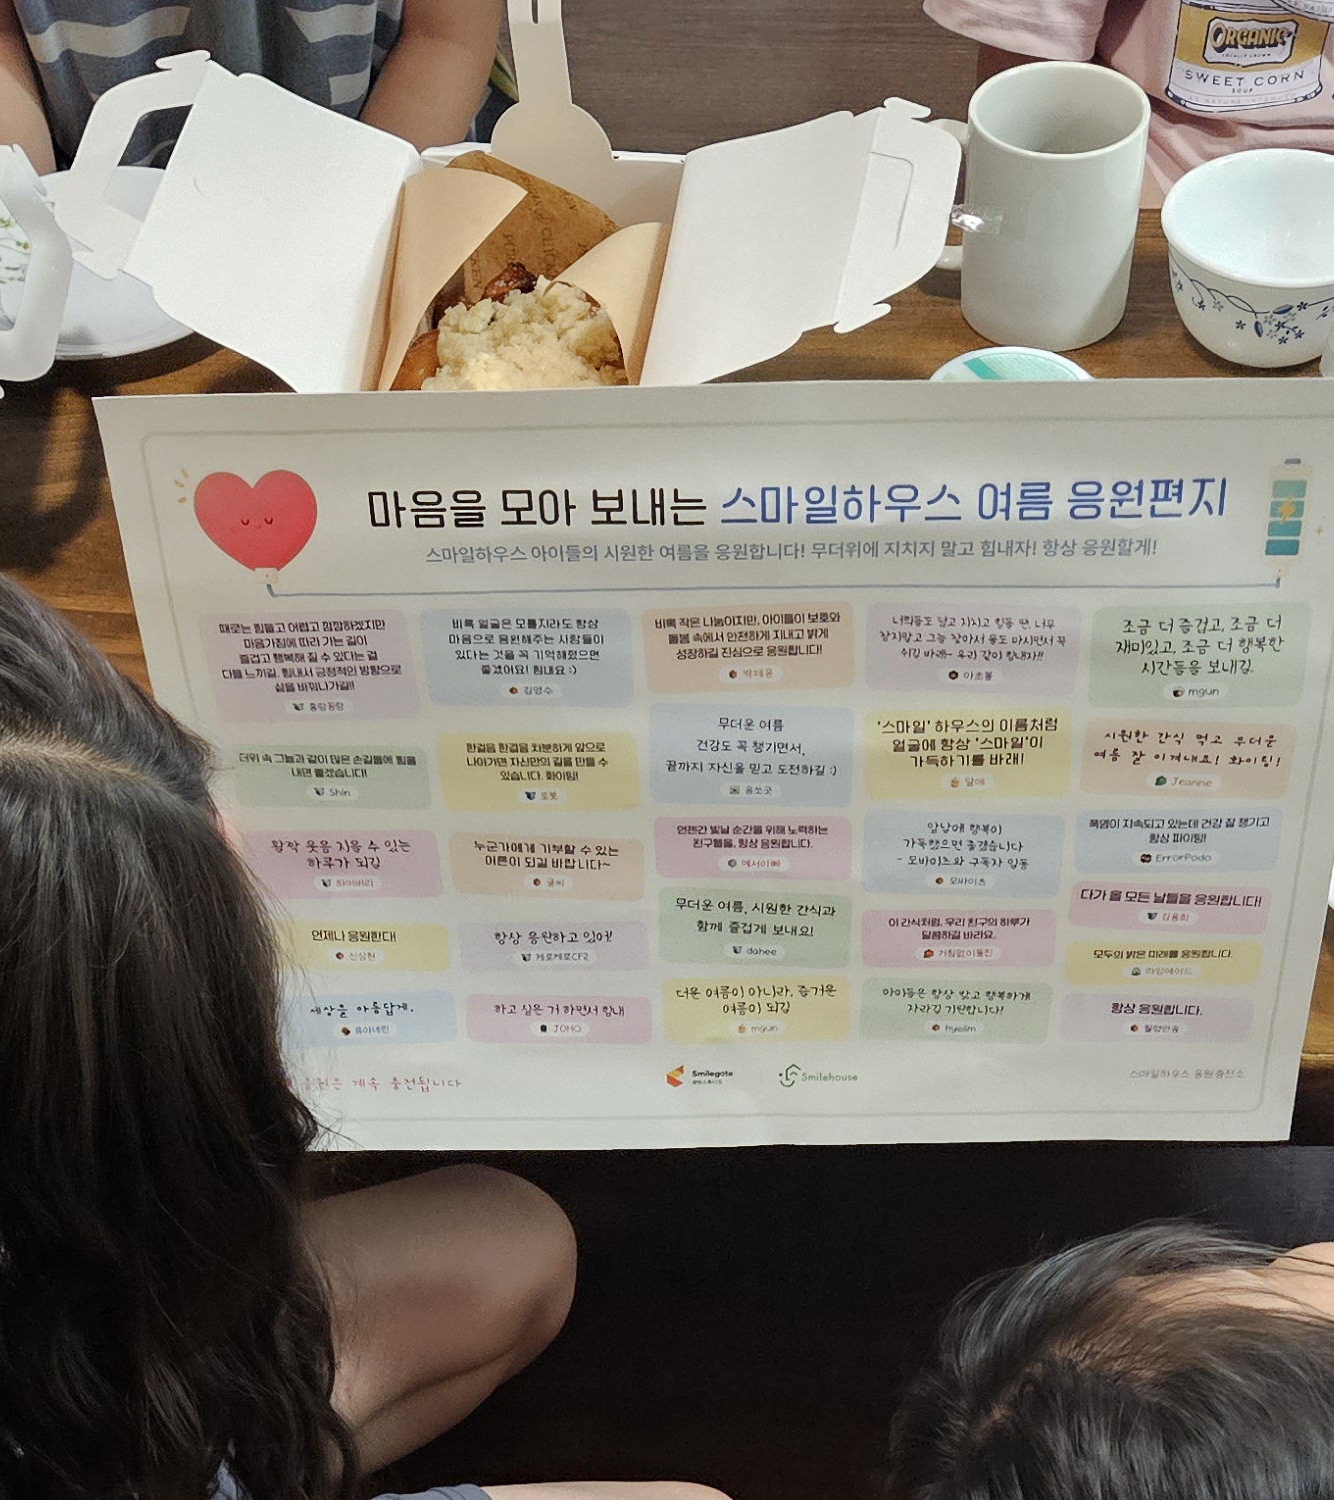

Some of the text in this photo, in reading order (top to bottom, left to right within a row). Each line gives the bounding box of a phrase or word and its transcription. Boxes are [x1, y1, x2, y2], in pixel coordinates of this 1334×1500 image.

[1210, 23, 1293, 53] ORGANIC
[1185, 70, 1305, 87] SWEET CORN
[367, 477, 1227, 529] 마음을 모아 보내는 스마일하우스 여름 응원편지
[425, 537, 1158, 564] 스마일하우스 아이들의 시원한 여름을 응원합니다! 무더위에 지치지 말고 힘내자! 항상 응원할게!
[219, 621, 320, 635] 때로는 힘들고 어렵고
[452, 618, 599, 629] 비록 얼굴은 모를지라도 항상
[655, 613, 805, 629] 비록 작은 아이들이
[1123, 614, 1282, 635] 조금 더 즐겁고, 조금 더
[299, 637, 320, 647] 따라
[449, 634, 604, 645] 마음으로 응원해주는 사람들이
[693, 628, 829, 643] 속에서 안전하게 지내고 밝게
[676, 644, 823, 660] 성장하길 진심으로 응원합니다!
[1116, 636, 1286, 656] 재미있고, 조금 더 행복한
[321, 651, 365, 662] 수 있다는
[455, 650, 529, 661] 있다는 것을 꼭
[957, 650, 977, 660] 우리
[1141, 658, 1254, 676] 시간들을 보내길.
[1188, 688, 1220, 698] mgun
[718, 718, 784, 732] 무더운 여름
[878, 718, 1058, 734] '스마일' 하우스의 이름처럼
[893, 736, 1043, 753] 얼굴에 항상 '스마일'이
[1105, 729, 1277, 748] 시원한 간식 먹고 무더운
[466, 742, 606, 754] 한걸음 한걸음 앞으로
[697, 739, 806, 756] 건강도 꼭 챙기면서,
[308, 754, 328, 765] 같이
[599, 757, 608, 767] 수
[910, 753, 1024, 768] 가득하기를 바래!
[1094, 748, 1220, 766] 여름 잘 이겨내요!
[666, 760, 825, 776] 끝까지 자신을 믿고 도전하길
[1171, 777, 1213, 788] Jeanne
[329, 788, 351, 797] Shin
[765, 825, 786, 835] 위해
[1089, 819, 1223, 830] 폭염이 지속되고 있는데 건강
[739, 839, 758, 849] 항상
[1149, 833, 1170, 844] 항상
[368, 839, 411, 853] 수 있는
[474, 841, 619, 857] 누군가에게 기부할 수 있는
[525, 857, 548, 868] 되길
[1156, 854, 1212, 863] ErrorPodo
[1080, 889, 1192, 905] 다가 모든 날들을
[676, 898, 836, 917] 무더운 시원한 간식과
[697, 920, 814, 937] 함께 즐겁게 보내요!
[945, 917, 966, 928] 우리
[312, 930, 346, 942] 언제나
[494, 931, 579, 945] 항상 응원하고
[746, 947, 777, 957] dahee
[1093, 950, 1123, 959] 모두의
[676, 984, 837, 1000] 더운 여름이 즐거운
[310, 1004, 349, 1019] 세상을
[495, 1004, 625, 1018] 하고 거 힘내
[723, 1001, 791, 1016] 여름이 되길
[1111, 1003, 1136, 1015] 항상
[553, 1025, 582, 1034] JOHO
[692, 1070, 734, 1079] Smilegate
[802, 1072, 859, 1082] Smilehouse
[352, 1077, 380, 1091] 계속
